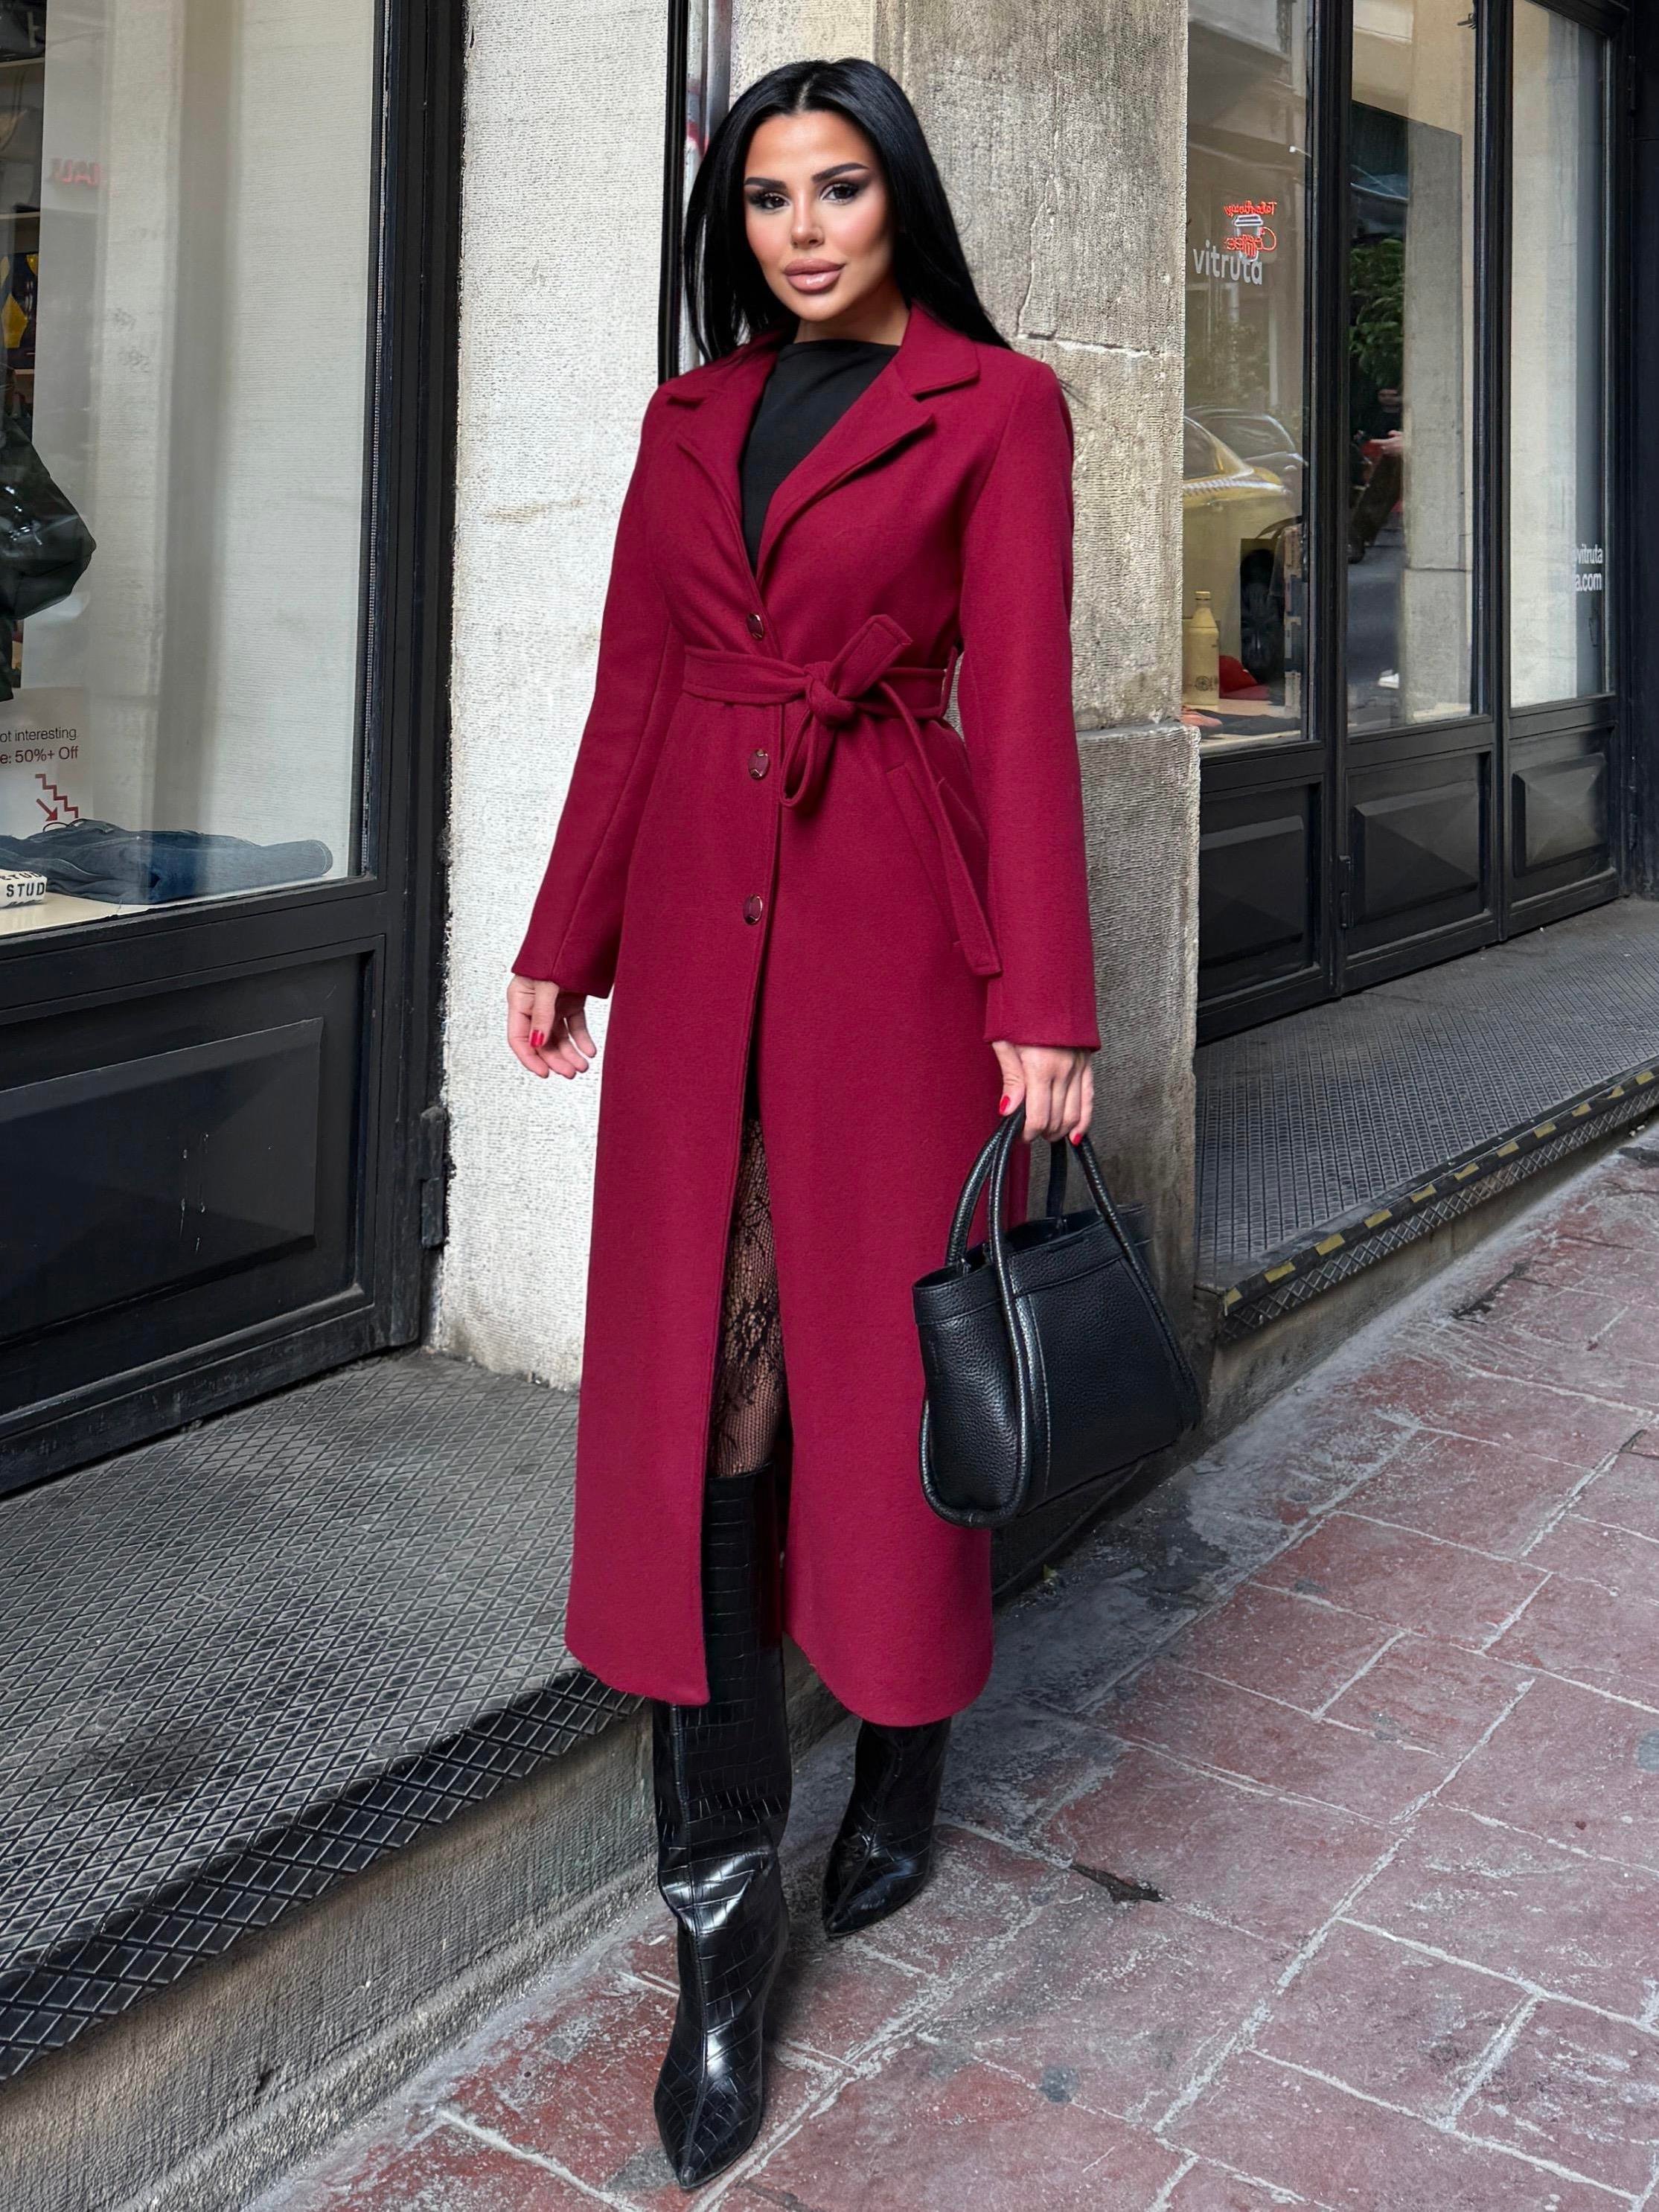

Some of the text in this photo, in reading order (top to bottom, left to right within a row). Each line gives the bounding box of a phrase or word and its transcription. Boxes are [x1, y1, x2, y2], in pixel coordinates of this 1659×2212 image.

[1193, 240, 1263, 285] vitruta
[1573, 543, 1603, 564] vitruta
[15, 727, 77, 741] interesting
[15, 747, 55, 763] 50%+
[59, 746, 78, 760] Off
[6, 882, 45, 898] STUD
